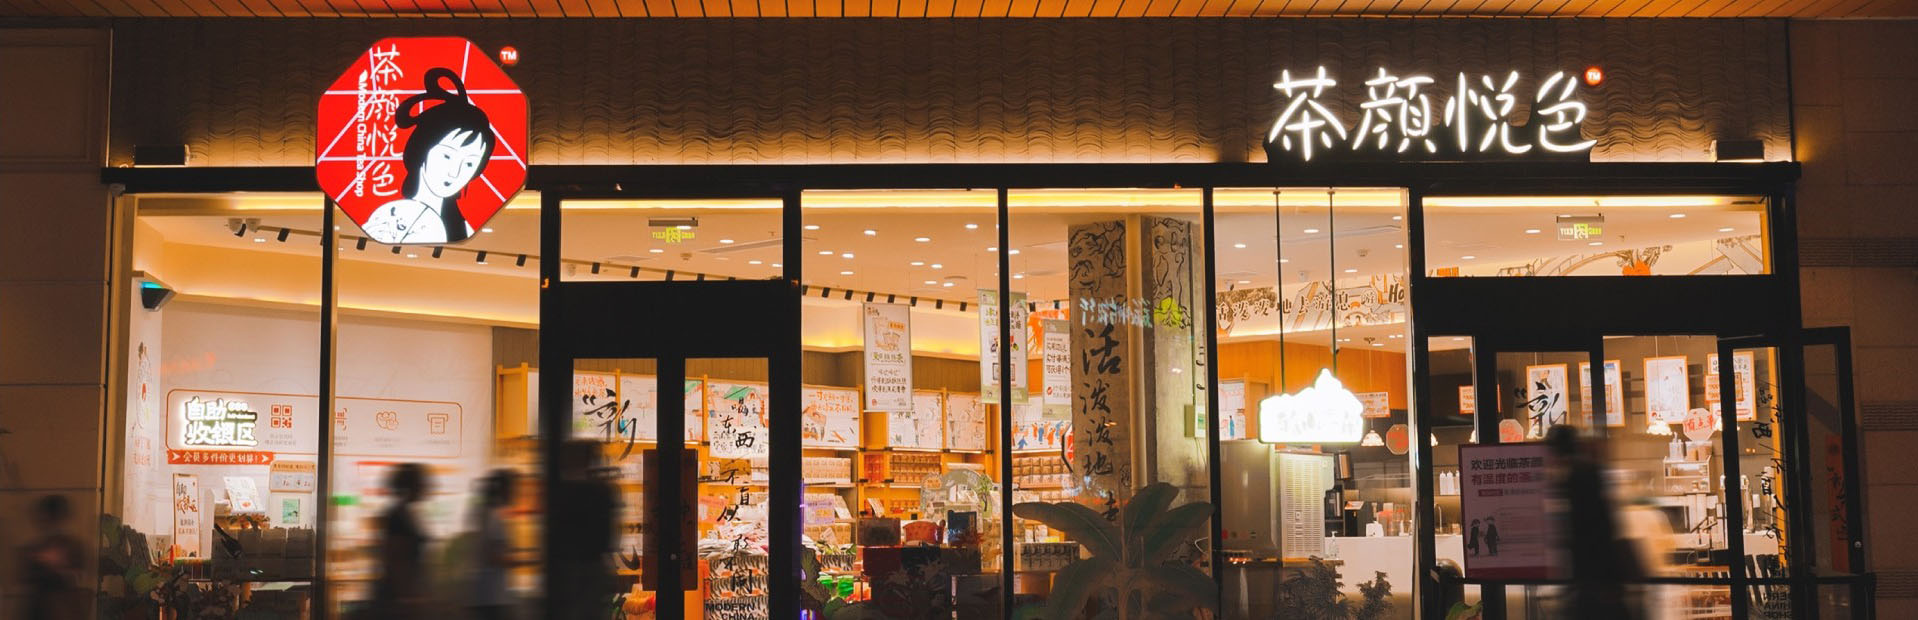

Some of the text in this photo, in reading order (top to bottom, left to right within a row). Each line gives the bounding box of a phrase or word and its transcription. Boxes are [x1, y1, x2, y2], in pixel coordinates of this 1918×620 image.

[501, 51, 517, 60] TM
[357, 123, 366, 151] China
[354, 171, 366, 197] Shop
